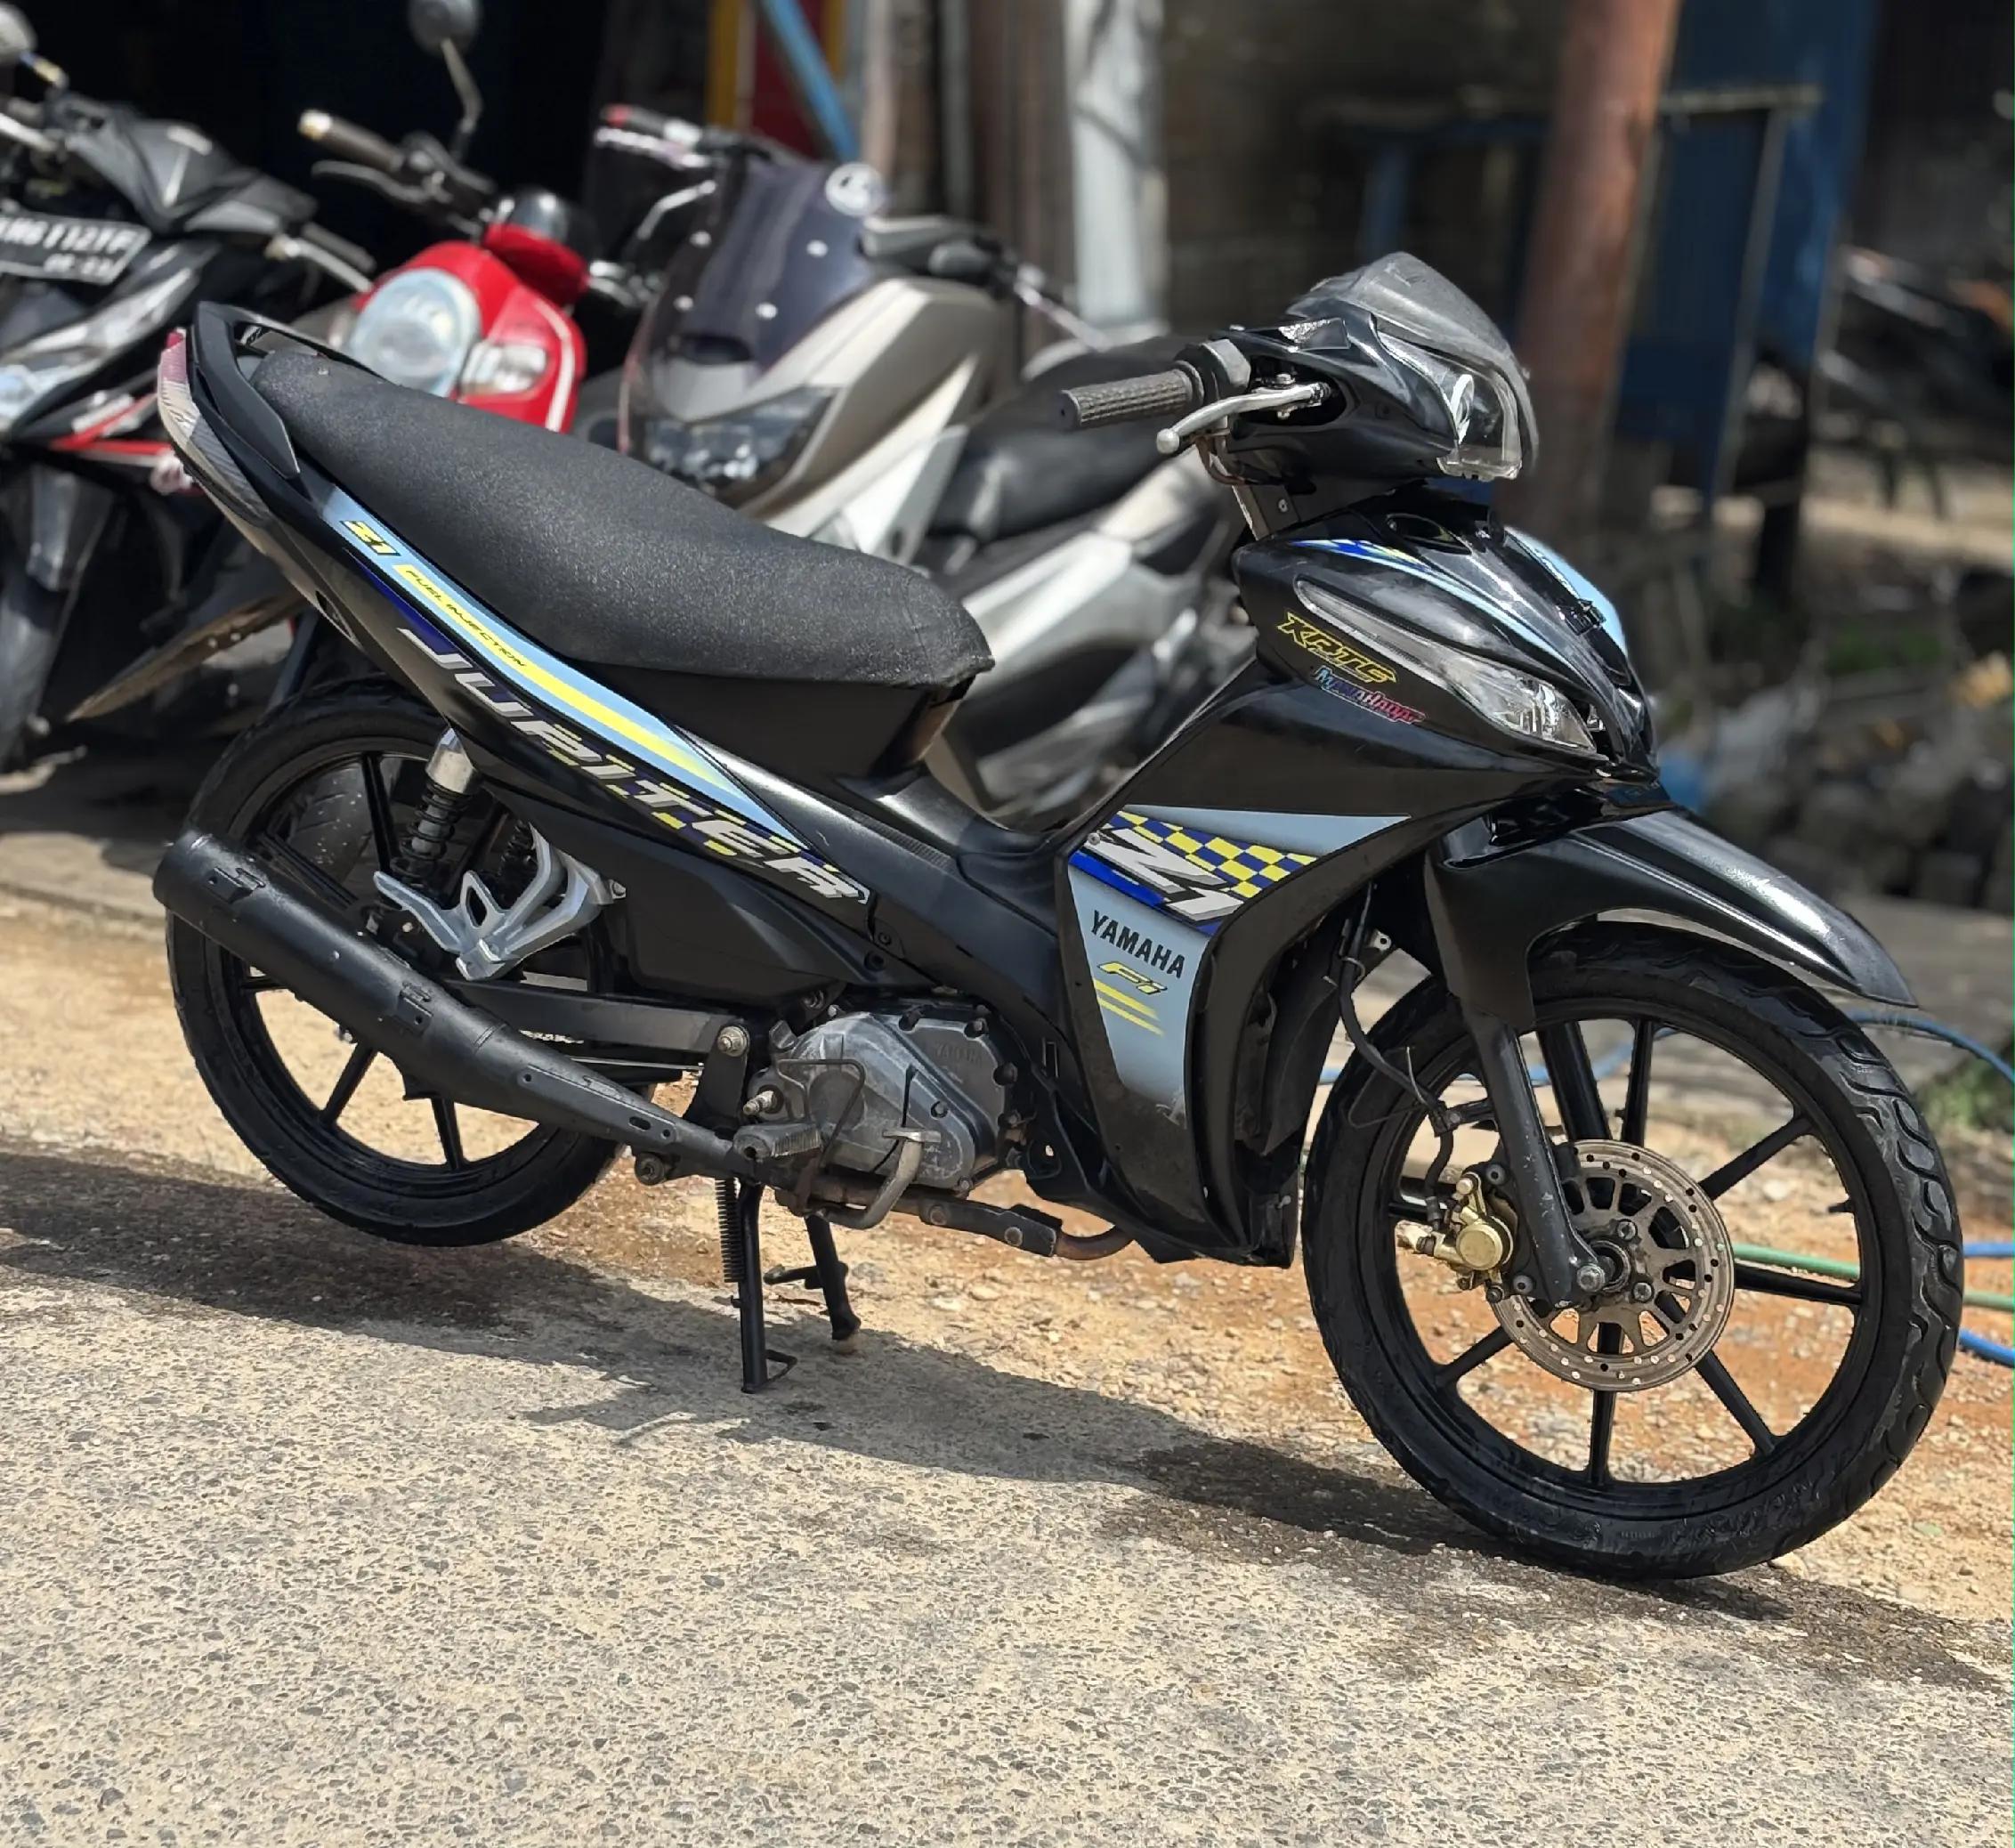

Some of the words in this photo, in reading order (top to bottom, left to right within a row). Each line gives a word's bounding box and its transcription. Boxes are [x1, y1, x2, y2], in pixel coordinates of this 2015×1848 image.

[405, 570, 442, 602] FUEL
[445, 603, 528, 667] INJECTION
[395, 627, 869, 904] JUPITER
[1091, 910, 1185, 979] YAMAHA
